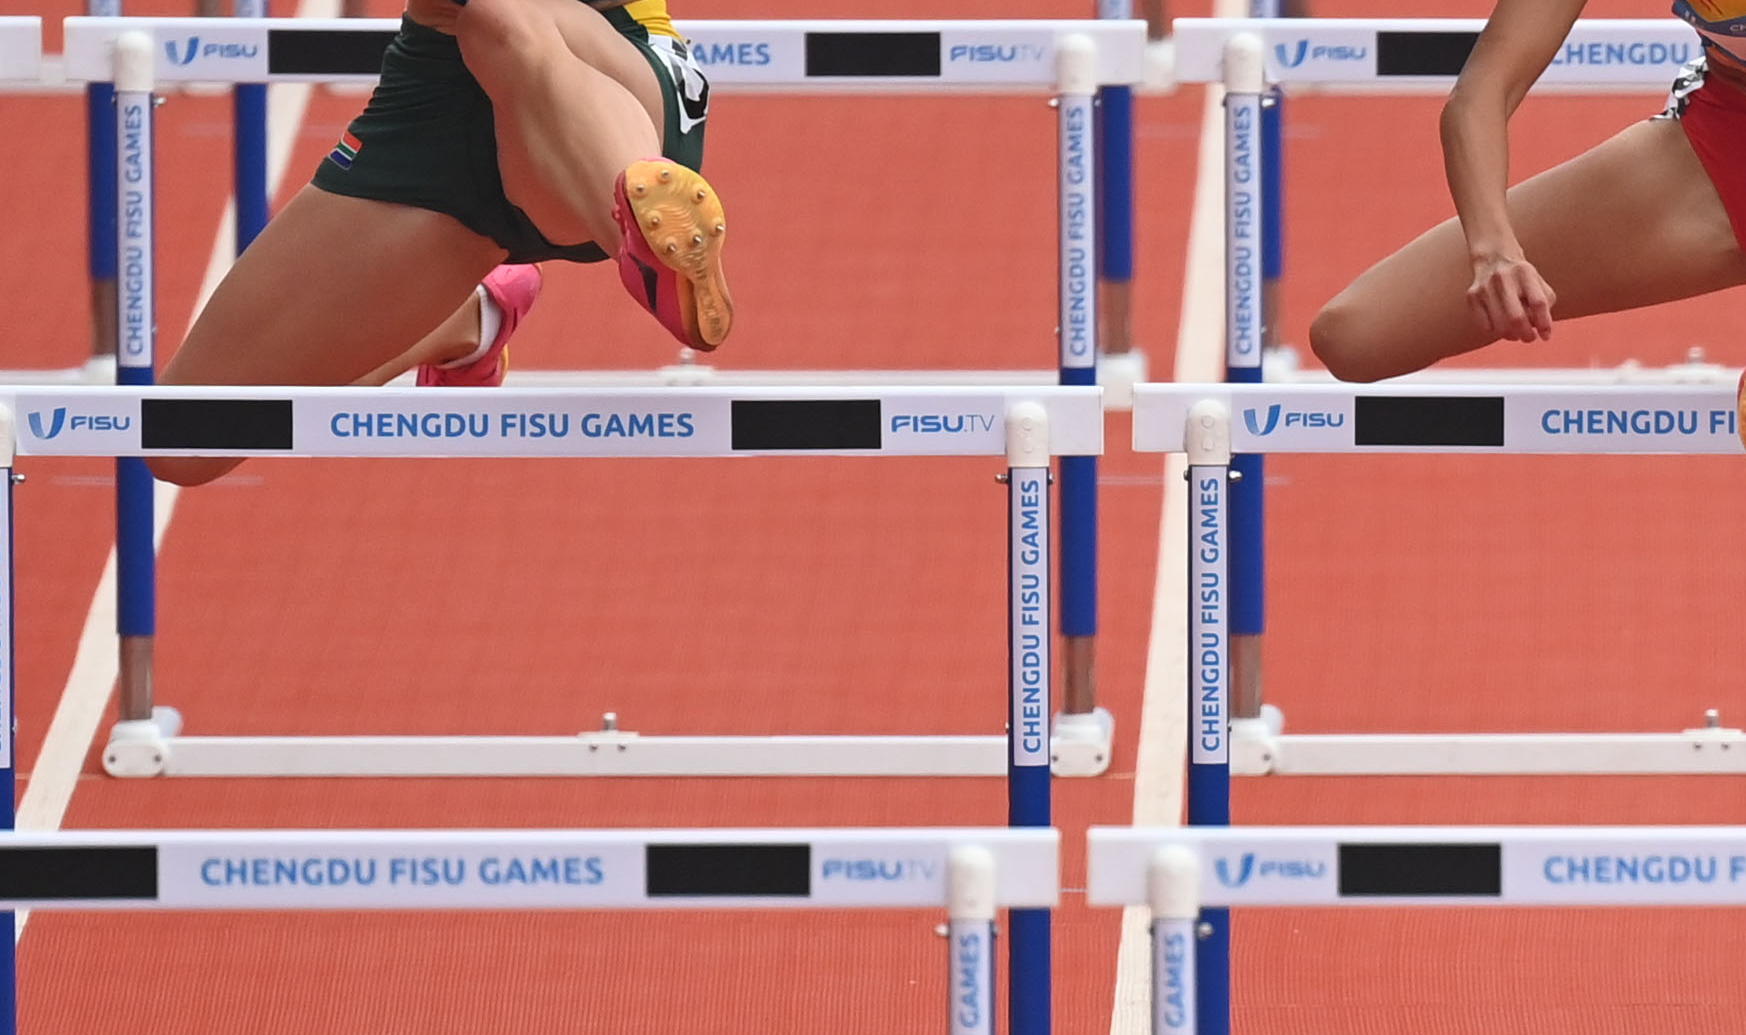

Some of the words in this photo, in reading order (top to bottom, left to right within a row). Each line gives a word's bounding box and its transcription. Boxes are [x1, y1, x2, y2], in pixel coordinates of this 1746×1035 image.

[203, 44, 258, 59] FISU
[690, 43, 773, 67] AMES
[1552, 42, 1690, 66] HENGDU
[125, 104, 143, 183] GAMES
[1067, 106, 1086, 185] GAMES
[1234, 105, 1252, 184] GAMES
[125, 190, 143, 239] FISU
[1067, 192, 1086, 241] FISU
[1234, 191, 1252, 239] FISU
[125, 246, 143, 356] CHENGDU
[1067, 248, 1086, 357] CHENGDU
[1234, 246, 1252, 355] CHENGDU
[71, 416, 131, 431] FISU
[331, 412, 490, 439] CHENGDU
[501, 412, 570, 439] FISU
[583, 412, 696, 438] GAMES
[1284, 411, 1345, 429] FISU
[1540, 409, 1698, 435] CHENGDU
[1021, 479, 1042, 566] GAMES
[1200, 477, 1221, 564] GAMES
[1021, 573, 1042, 626] FISU
[1200, 572, 1221, 624] FISU
[1021, 634, 1042, 754] CHENGDU
[1200, 632, 1221, 752] CHENGDU
[200, 857, 378, 888] CHENGDU
[390, 857, 467, 886] FISU
[478, 856, 606, 886] GAMES
[1260, 860, 1326, 878] FISU
[1543, 854, 1719, 885] CHENGDU
[959, 933, 980, 1028] GAMES
[1164, 933, 1184, 1028] GAMES
